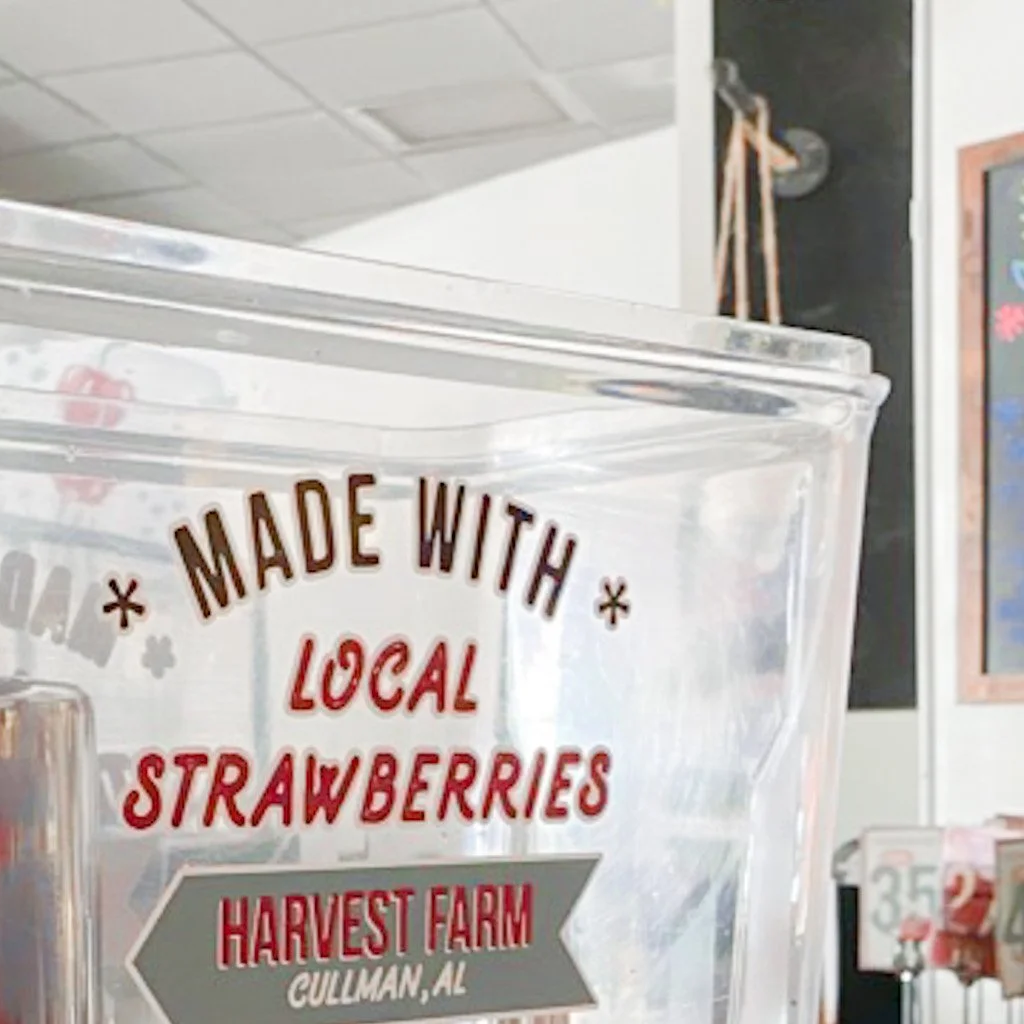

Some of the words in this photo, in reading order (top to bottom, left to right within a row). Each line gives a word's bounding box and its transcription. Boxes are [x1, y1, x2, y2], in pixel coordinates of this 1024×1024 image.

[174, 473, 380, 619] MADE
[417, 476, 576, 618] WITH
[288, 637, 478, 713] LOCAL
[122, 751, 612, 830] STRAWBERRIES
[216, 886, 414, 970] HARVEST
[424, 882, 534, 955] FARM
